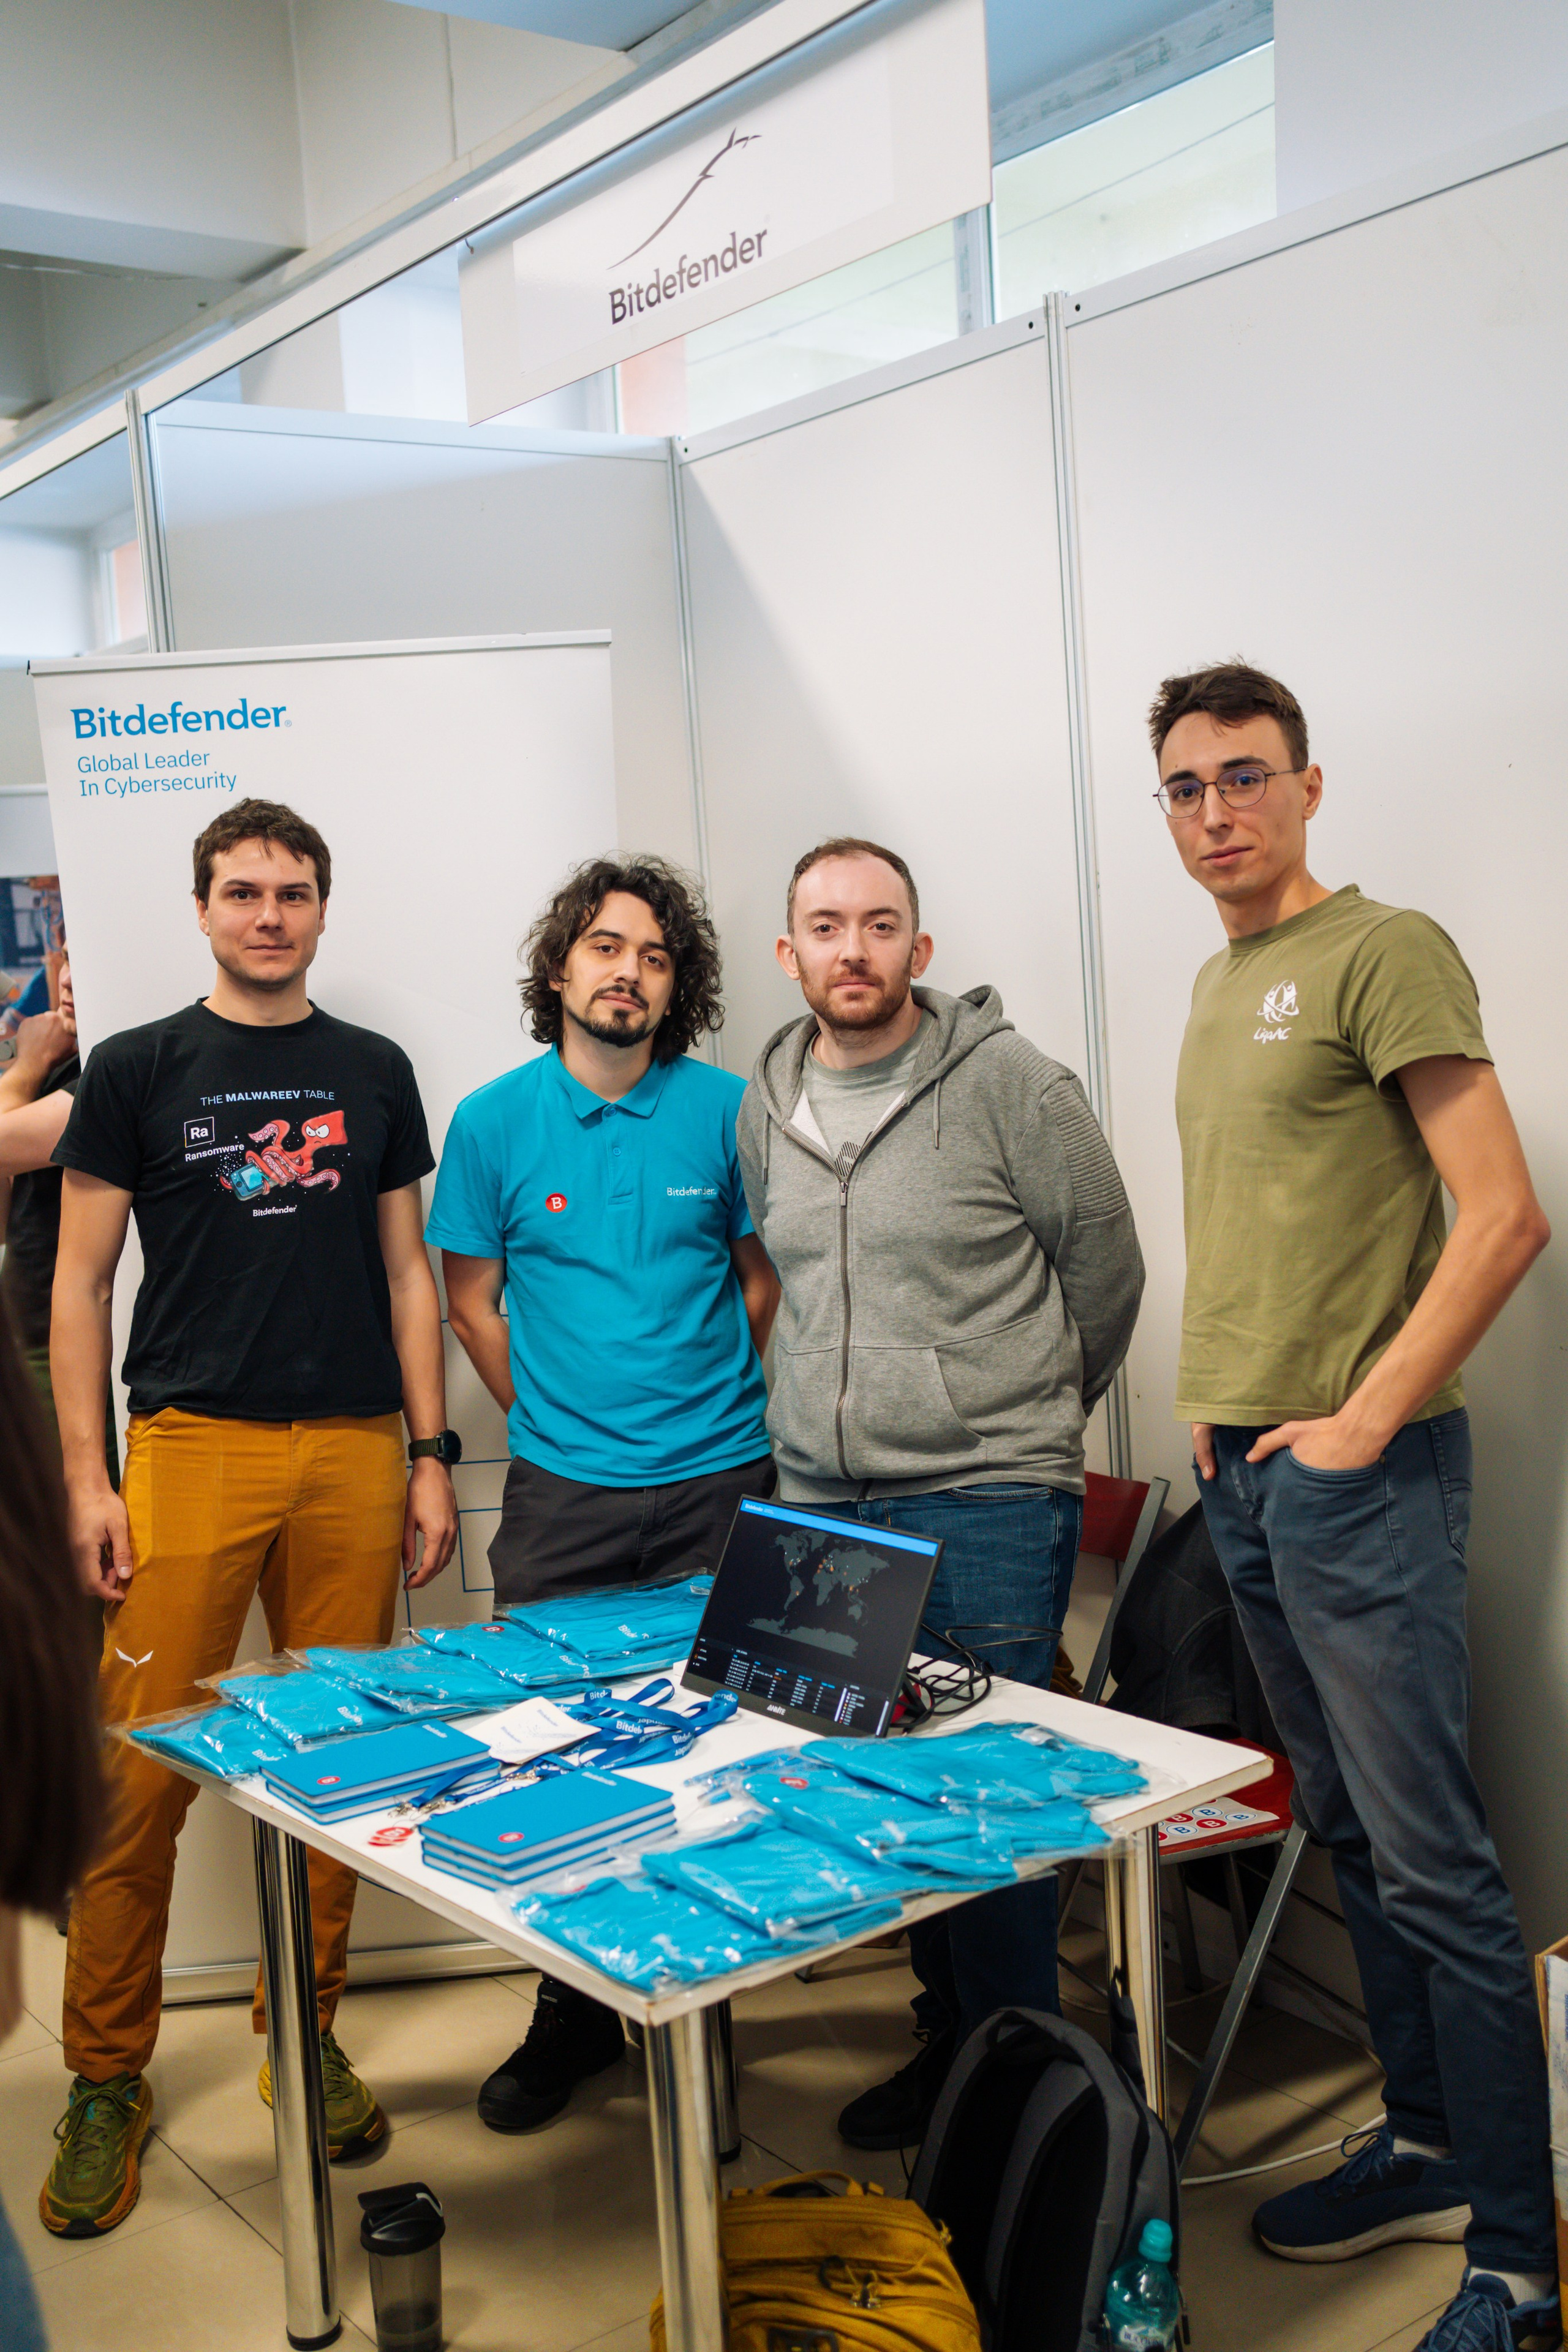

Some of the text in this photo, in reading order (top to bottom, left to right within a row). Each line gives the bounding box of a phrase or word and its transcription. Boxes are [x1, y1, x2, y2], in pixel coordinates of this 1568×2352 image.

[608, 229, 767, 325] Bitdefender
[70, 698, 287, 739] Bitdefender
[78, 750, 210, 773] Global Leader
[80, 771, 237, 798] In Cybersecurity
[200, 1090, 335, 1106] THE MALWAREEV TABLE
[190, 1127, 209, 1139] Ra
[185, 1144, 244, 1162] Ransomware
[252, 1206, 296, 1217] Bitdefender
[551, 1197, 562, 1209] B
